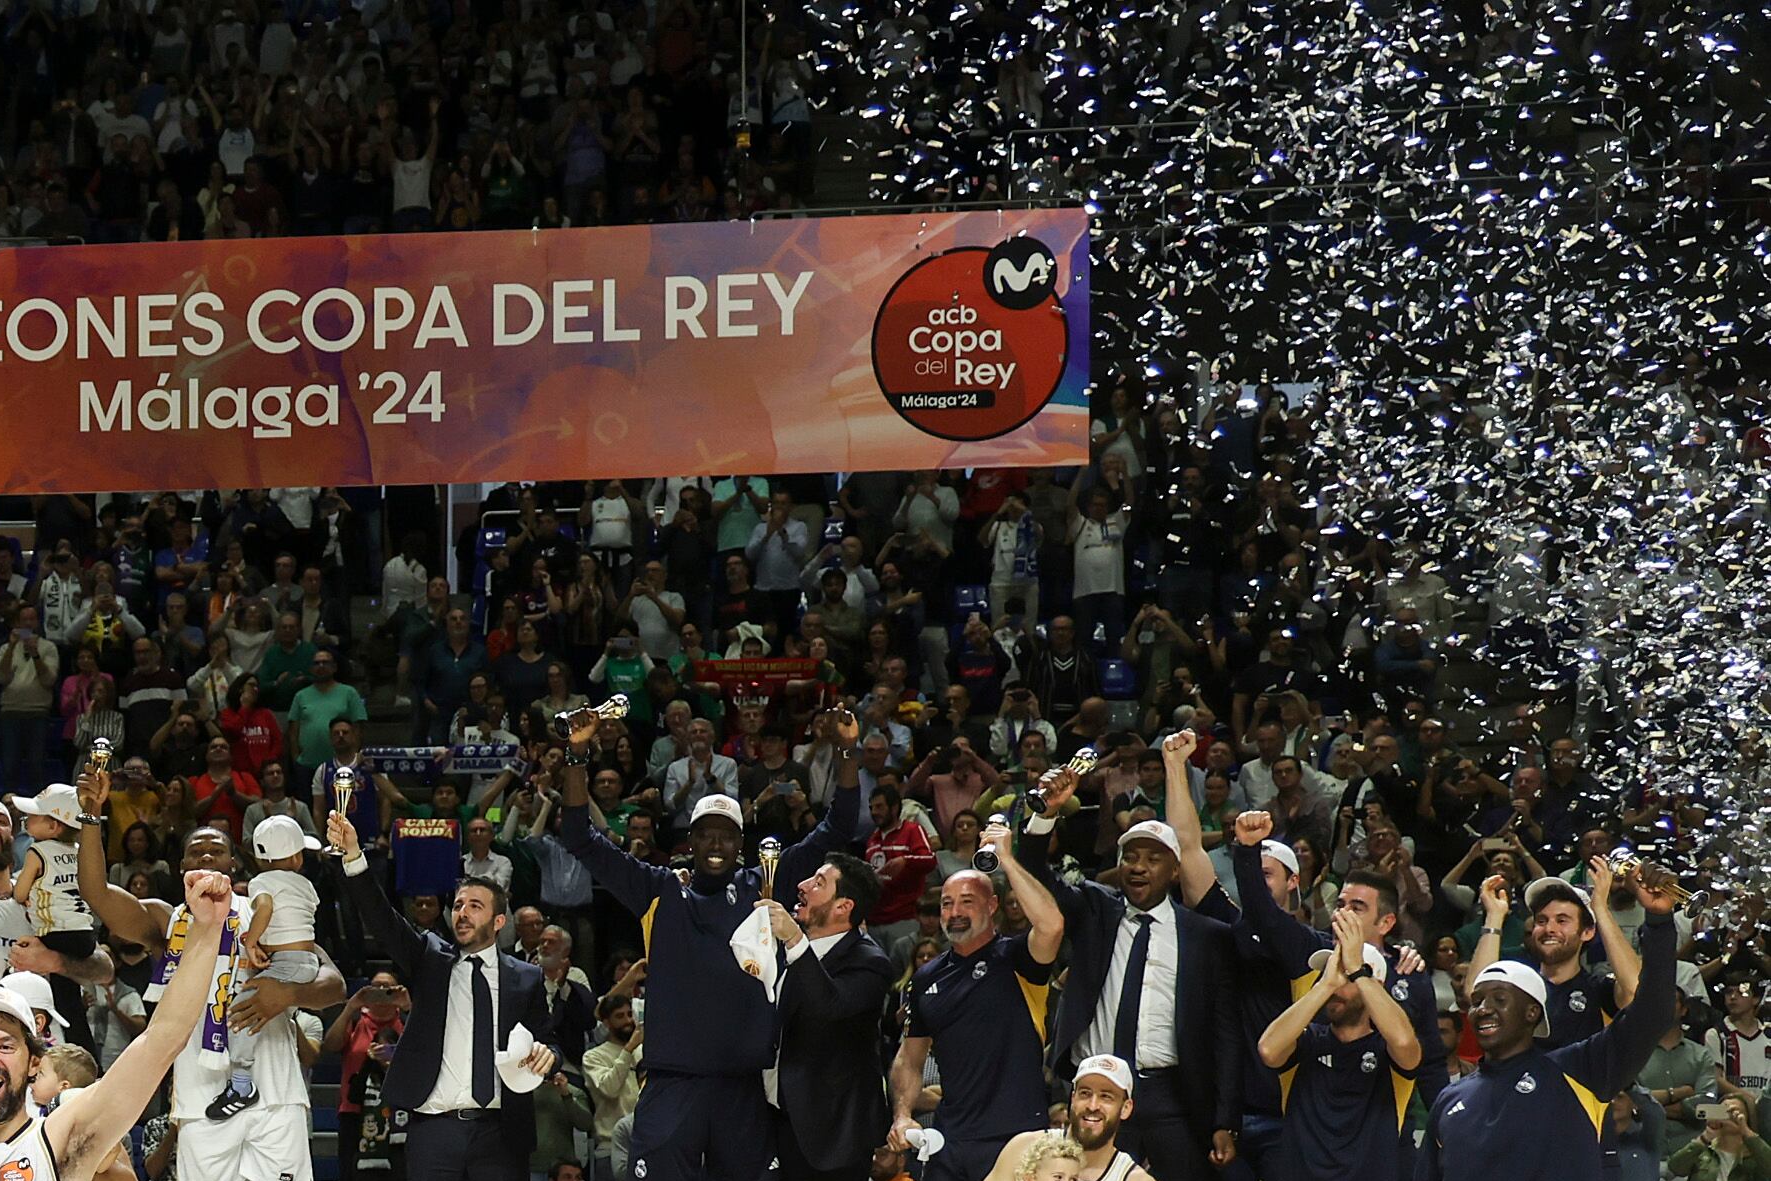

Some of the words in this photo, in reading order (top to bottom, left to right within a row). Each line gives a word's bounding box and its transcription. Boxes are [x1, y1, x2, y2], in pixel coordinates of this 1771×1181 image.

[246, 284, 469, 356] COPA
[493, 280, 640, 346] DEL
[665, 271, 815, 340] REY
[928, 304, 977, 326] acb
[908, 326, 1002, 358] Copa
[914, 357, 948, 377] del
[954, 359, 1016, 391] Rey
[79, 372, 339, 439] Málaga
